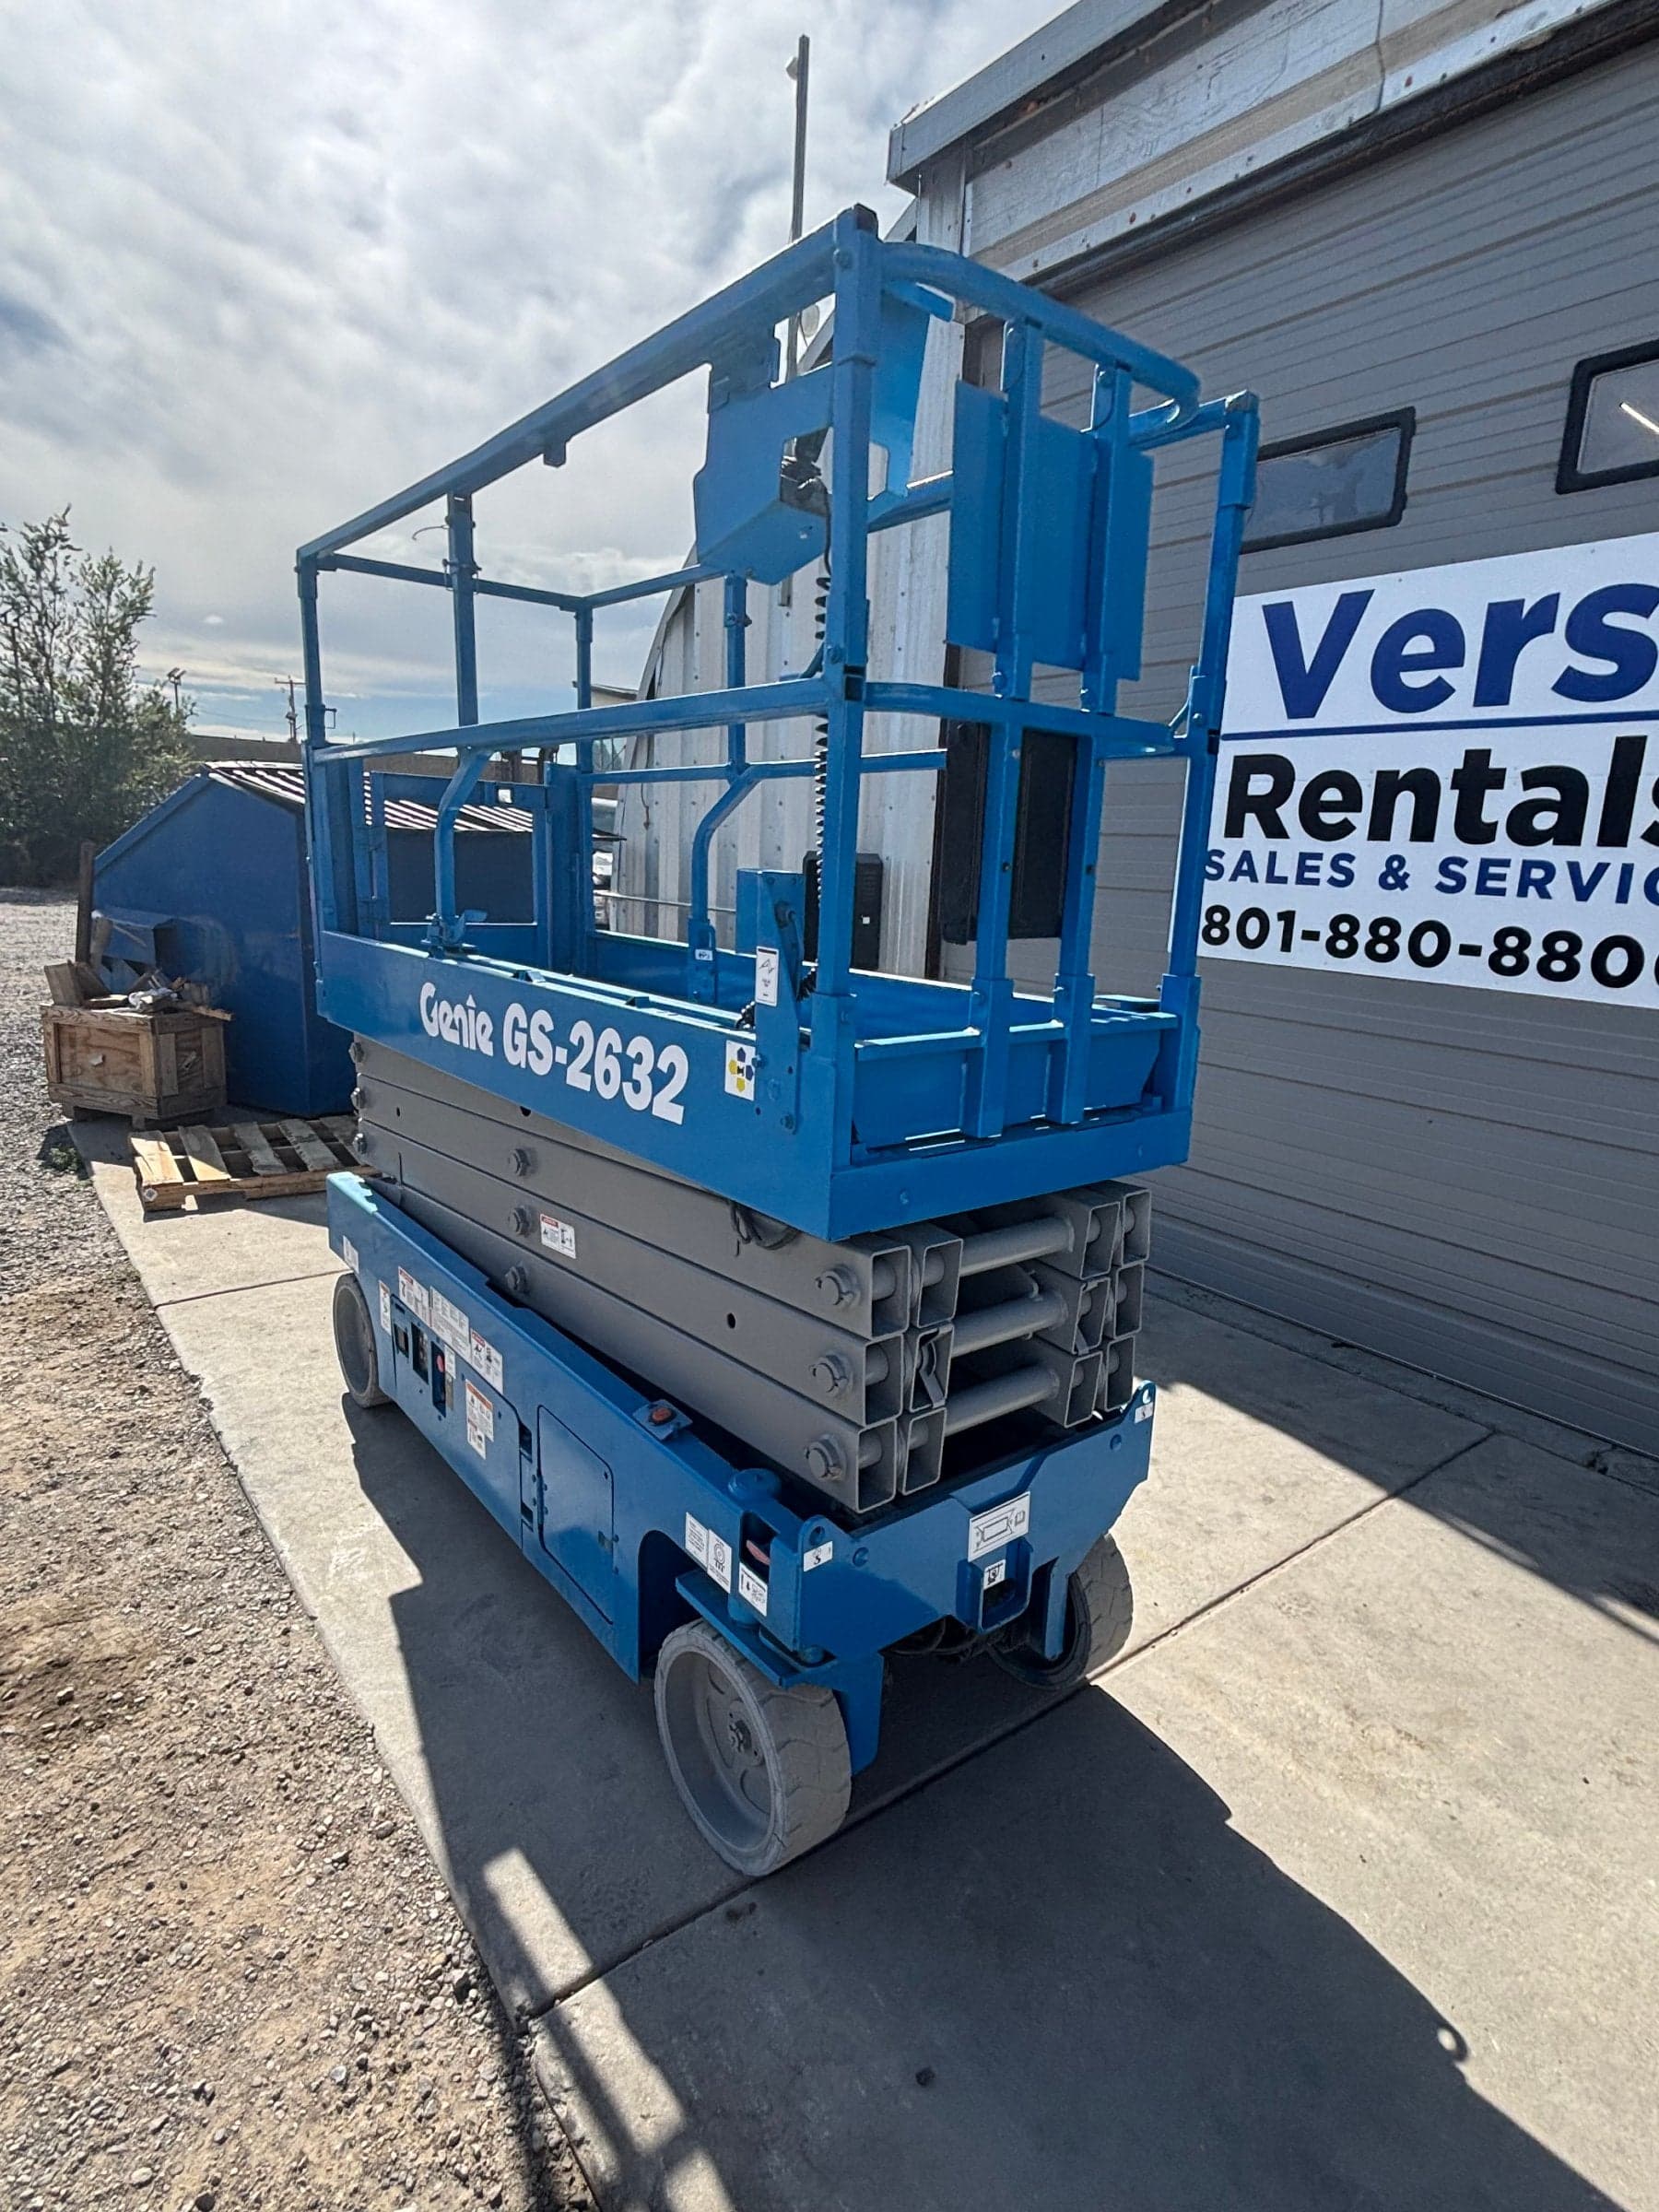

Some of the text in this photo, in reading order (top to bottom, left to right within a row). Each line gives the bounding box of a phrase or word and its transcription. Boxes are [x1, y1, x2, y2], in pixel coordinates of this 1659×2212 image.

[1262, 583, 1659, 719] Vers
[1204, 849, 1356, 888] SALES
[1379, 854, 1410, 891] &
[1201, 904, 1659, 989] 801-880-880
[419, 982, 689, 1126] Genie GS-2632
